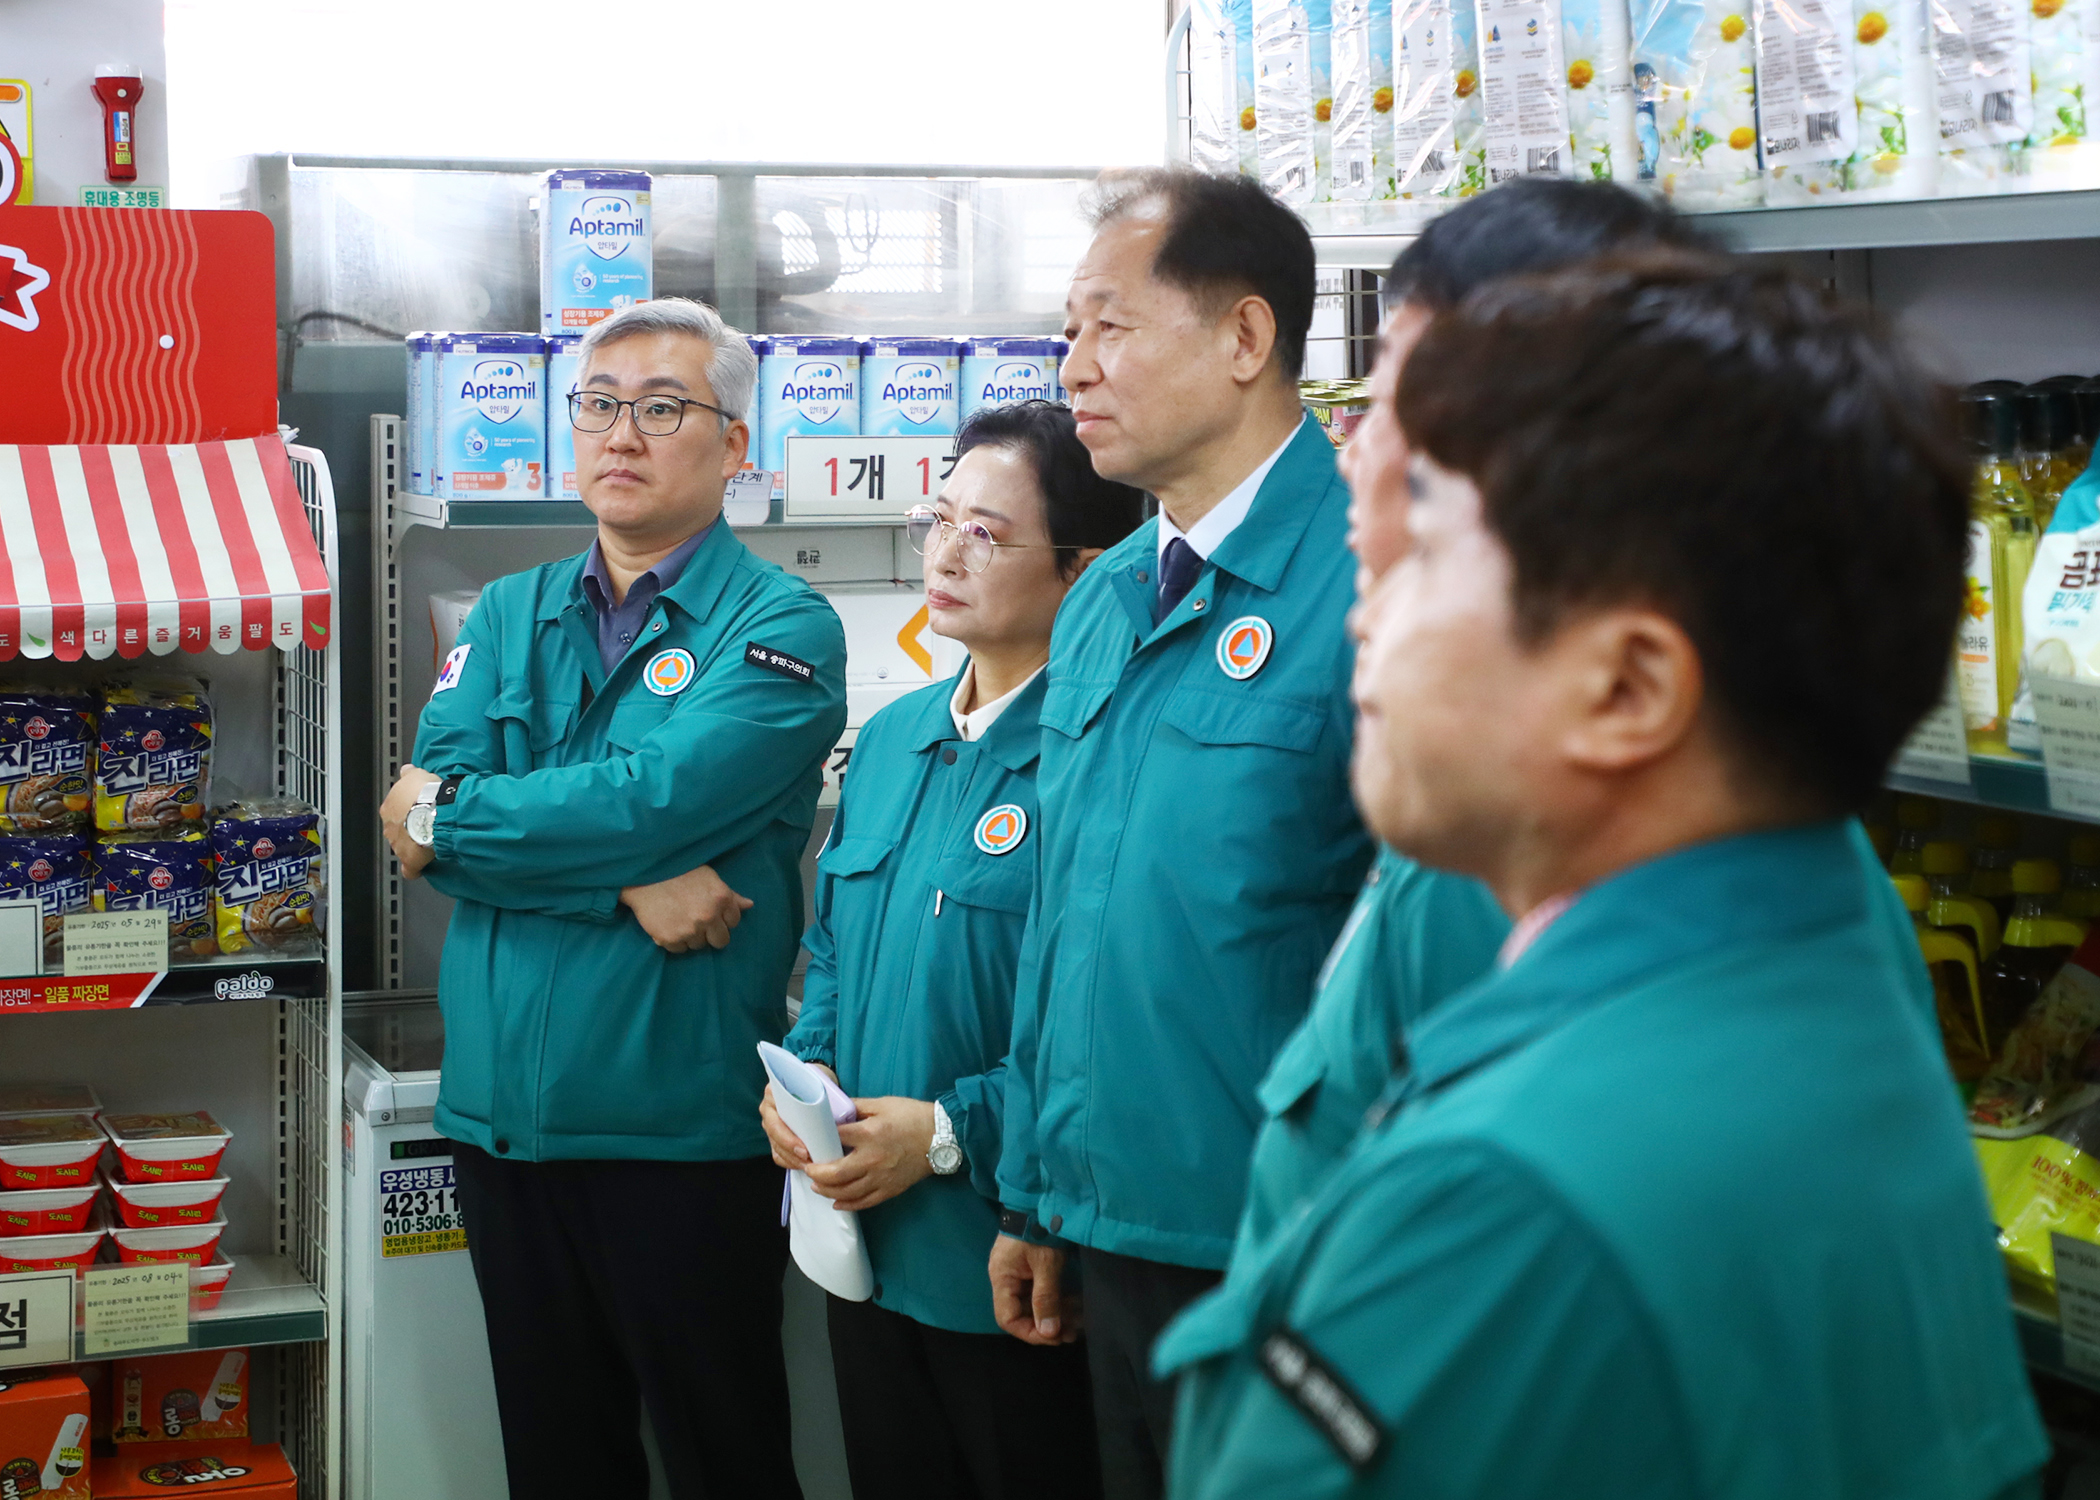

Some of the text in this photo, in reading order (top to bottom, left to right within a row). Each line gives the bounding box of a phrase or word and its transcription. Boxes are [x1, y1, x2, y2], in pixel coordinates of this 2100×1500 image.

[85, 190, 160, 207] 휴대용 조명등
[569, 217, 644, 239] Aptamil
[597, 241, 618, 250] 압타밀
[461, 381, 536, 403] Aptamil
[781, 382, 853, 403] Aptamil
[882, 383, 953, 403] Aptamil
[982, 382, 1051, 403] Aptamil
[489, 405, 510, 414] 압타밀
[809, 406, 829, 415] 압타밀
[909, 406, 929, 415] 압타밀
[526, 462, 541, 490] 3
[824, 455, 885, 500] 1개
[155, 625, 232, 643] 즐거움
[248, 622, 294, 639] 팔도
[749, 648, 811, 678] 서울 송파구의회
[102, 750, 201, 797] 진라면
[60, 780, 84, 792] 순한맛
[217, 857, 310, 908] 진라면
[289, 892, 310, 908] 순한맛
[91, 920, 110, 930] 2025
[121, 918, 133, 928] 05
[144, 918, 156, 930] 29
[0, 987, 31, 1007] 장면!
[44, 986, 70, 1004] 일품
[72, 984, 110, 1002] 짜장면
[216, 971, 273, 1000] paldo
[382, 1168, 445, 1191] 우성냉동
[2032, 1155, 2073, 1188] 100%
[112, 1275, 130, 1286] 2025
[141, 1273, 153, 1283] 08
[164, 1272, 177, 1284] 04
[164, 1407, 181, 1435] 롱
